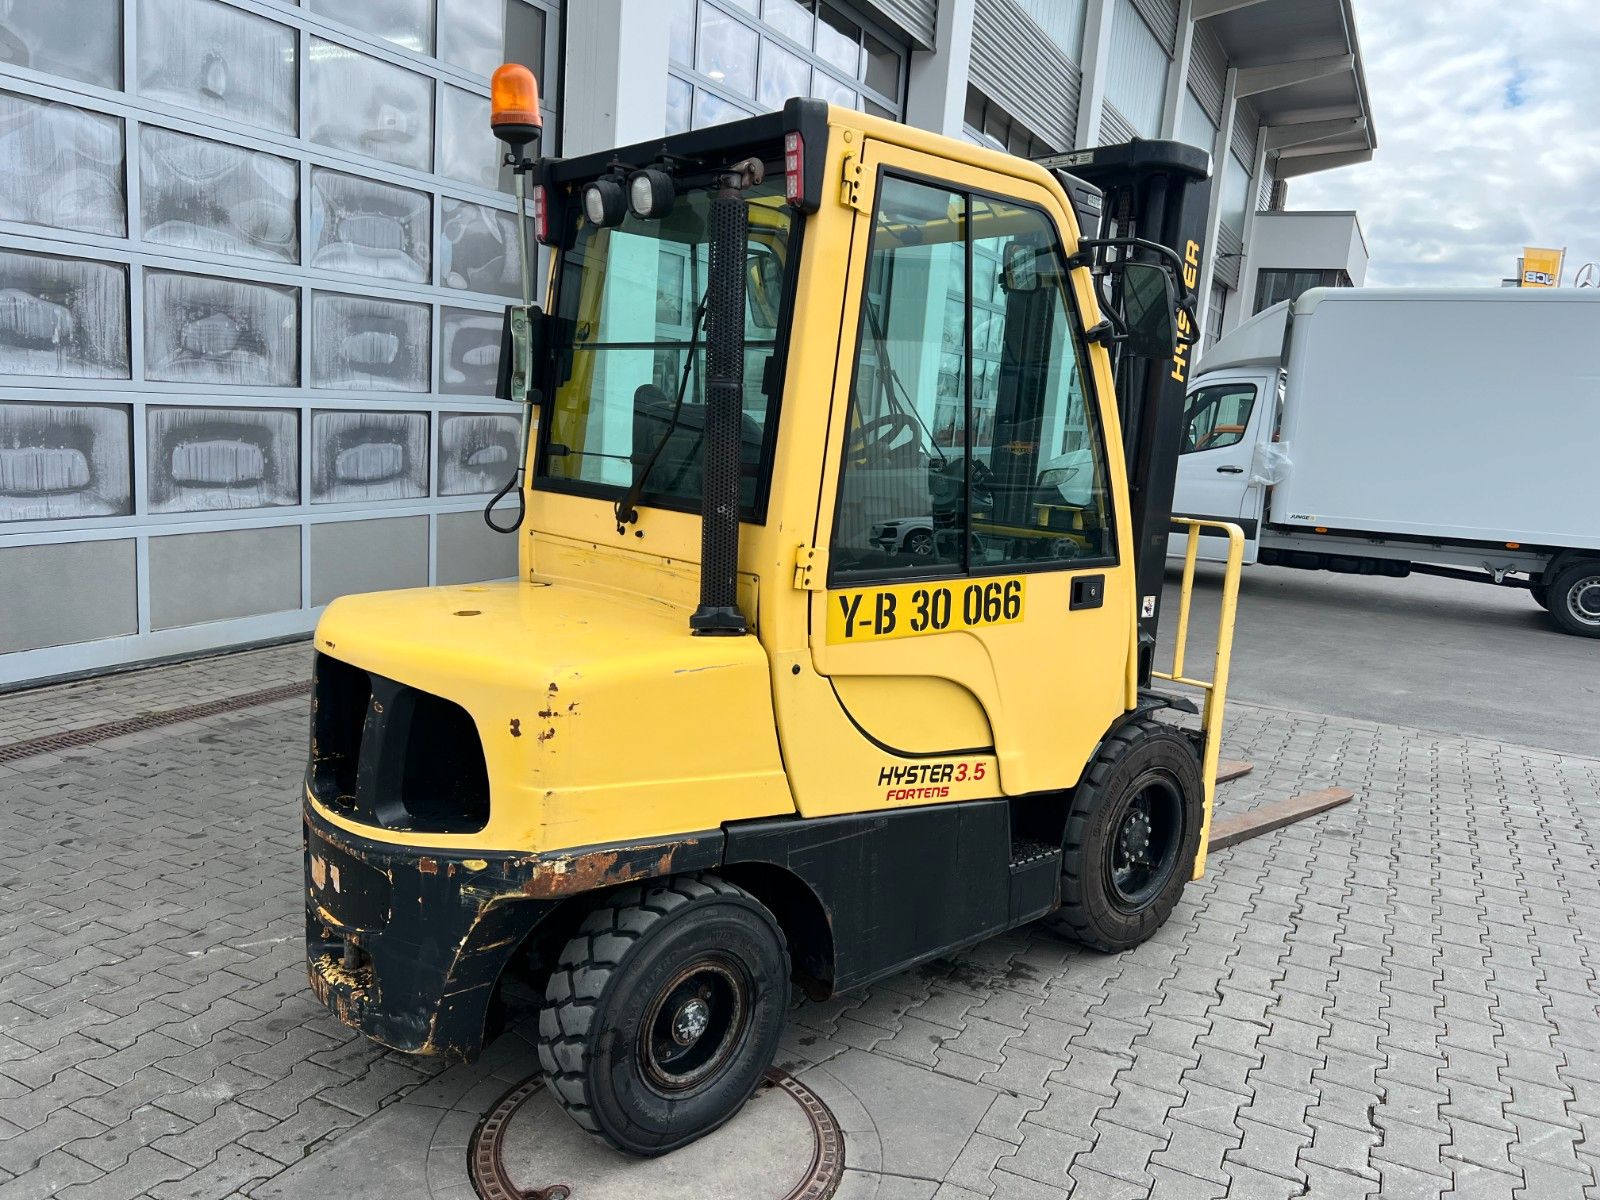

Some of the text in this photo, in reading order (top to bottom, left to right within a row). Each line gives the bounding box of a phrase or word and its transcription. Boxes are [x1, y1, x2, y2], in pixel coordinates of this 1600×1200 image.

[1171, 239, 1199, 383] HYSER
[839, 580, 1021, 638] Y-B 30 066
[878, 763, 985, 786] HYSTER 3.5
[886, 787, 949, 801] FORTENS
